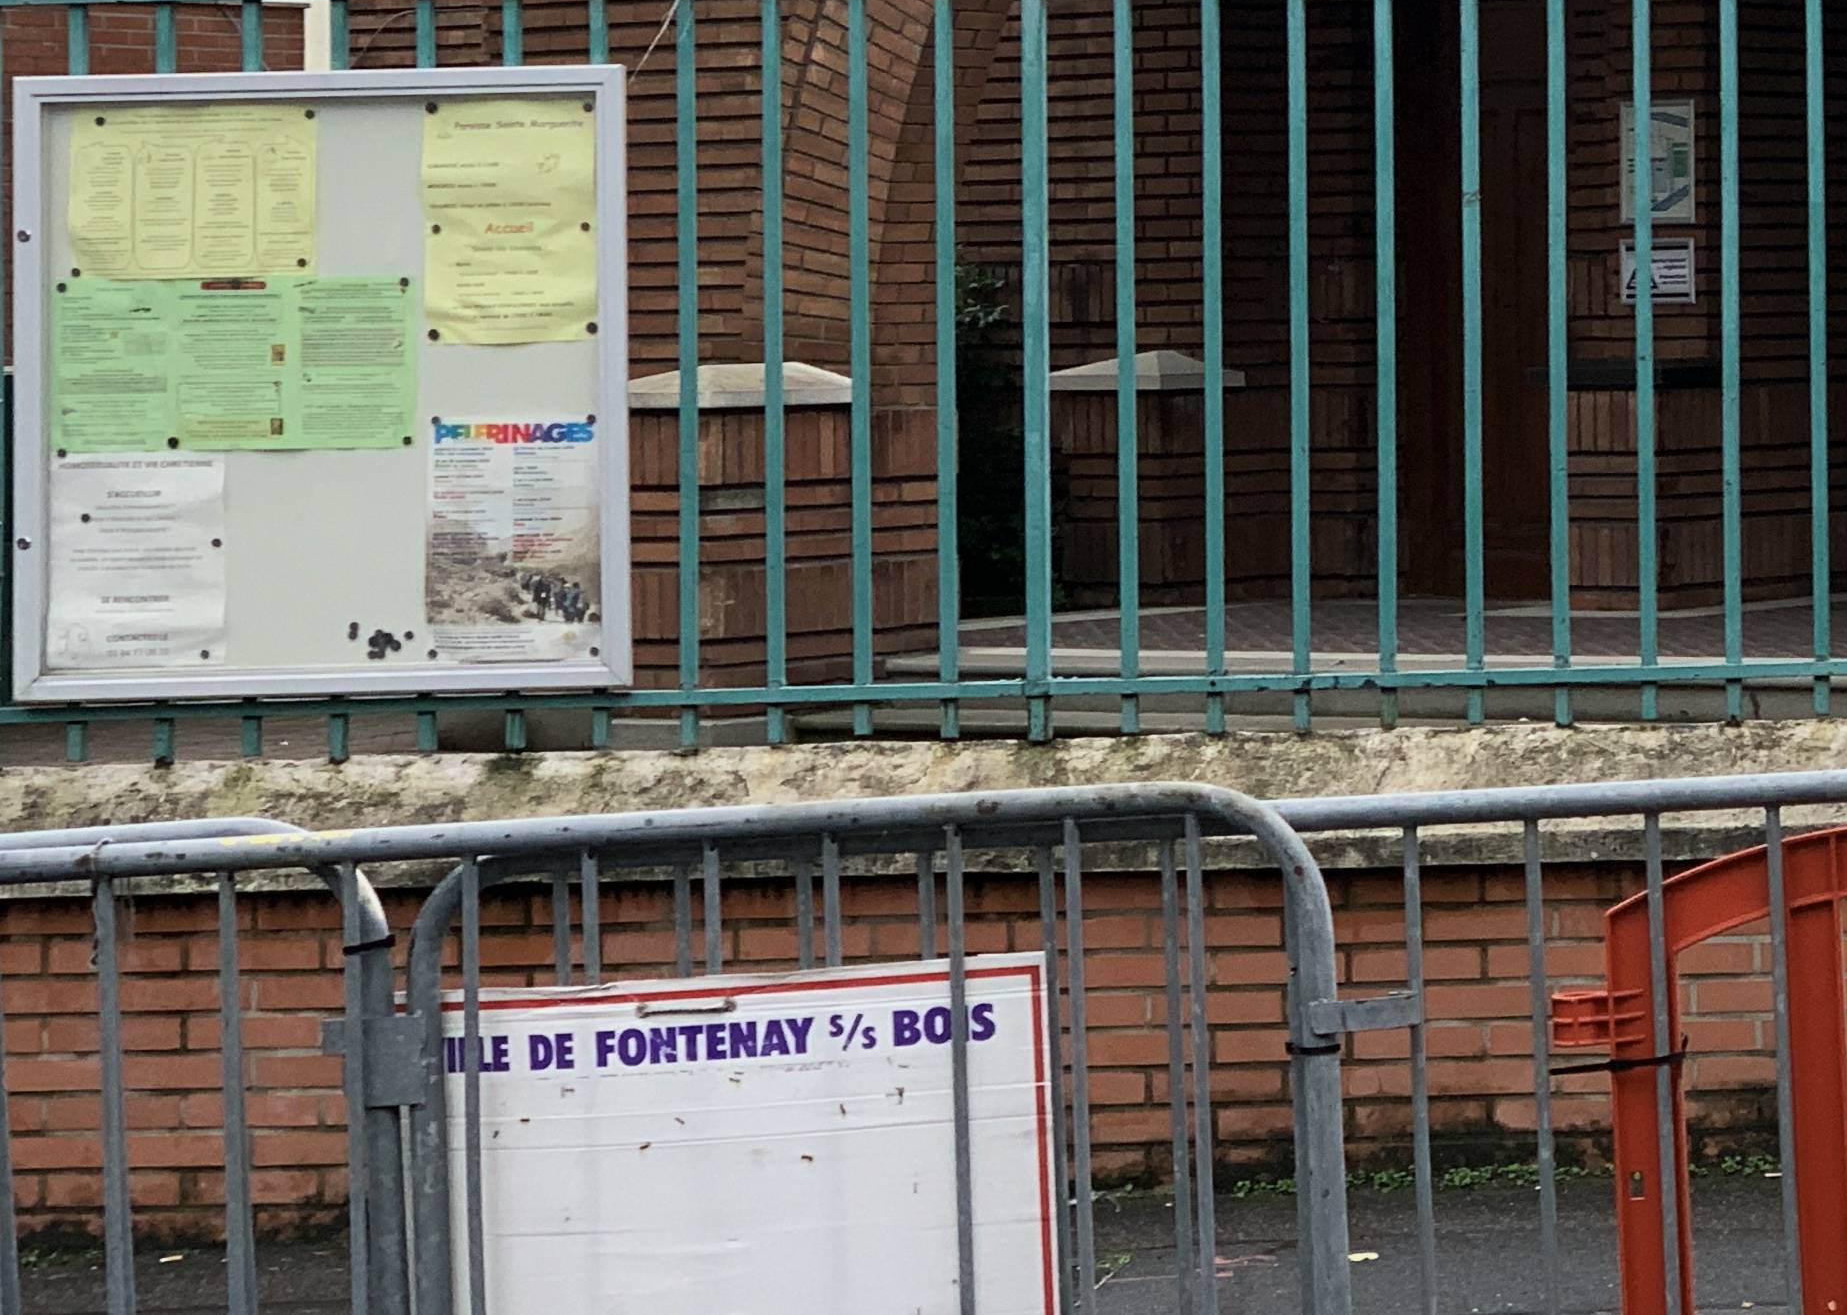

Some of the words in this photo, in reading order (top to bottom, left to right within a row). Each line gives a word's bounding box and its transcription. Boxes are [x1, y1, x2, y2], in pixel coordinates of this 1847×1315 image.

[484, 221, 535, 234] Accueil
[528, 1032, 576, 1071] DE
[595, 1015, 815, 1068] FONTENAY
